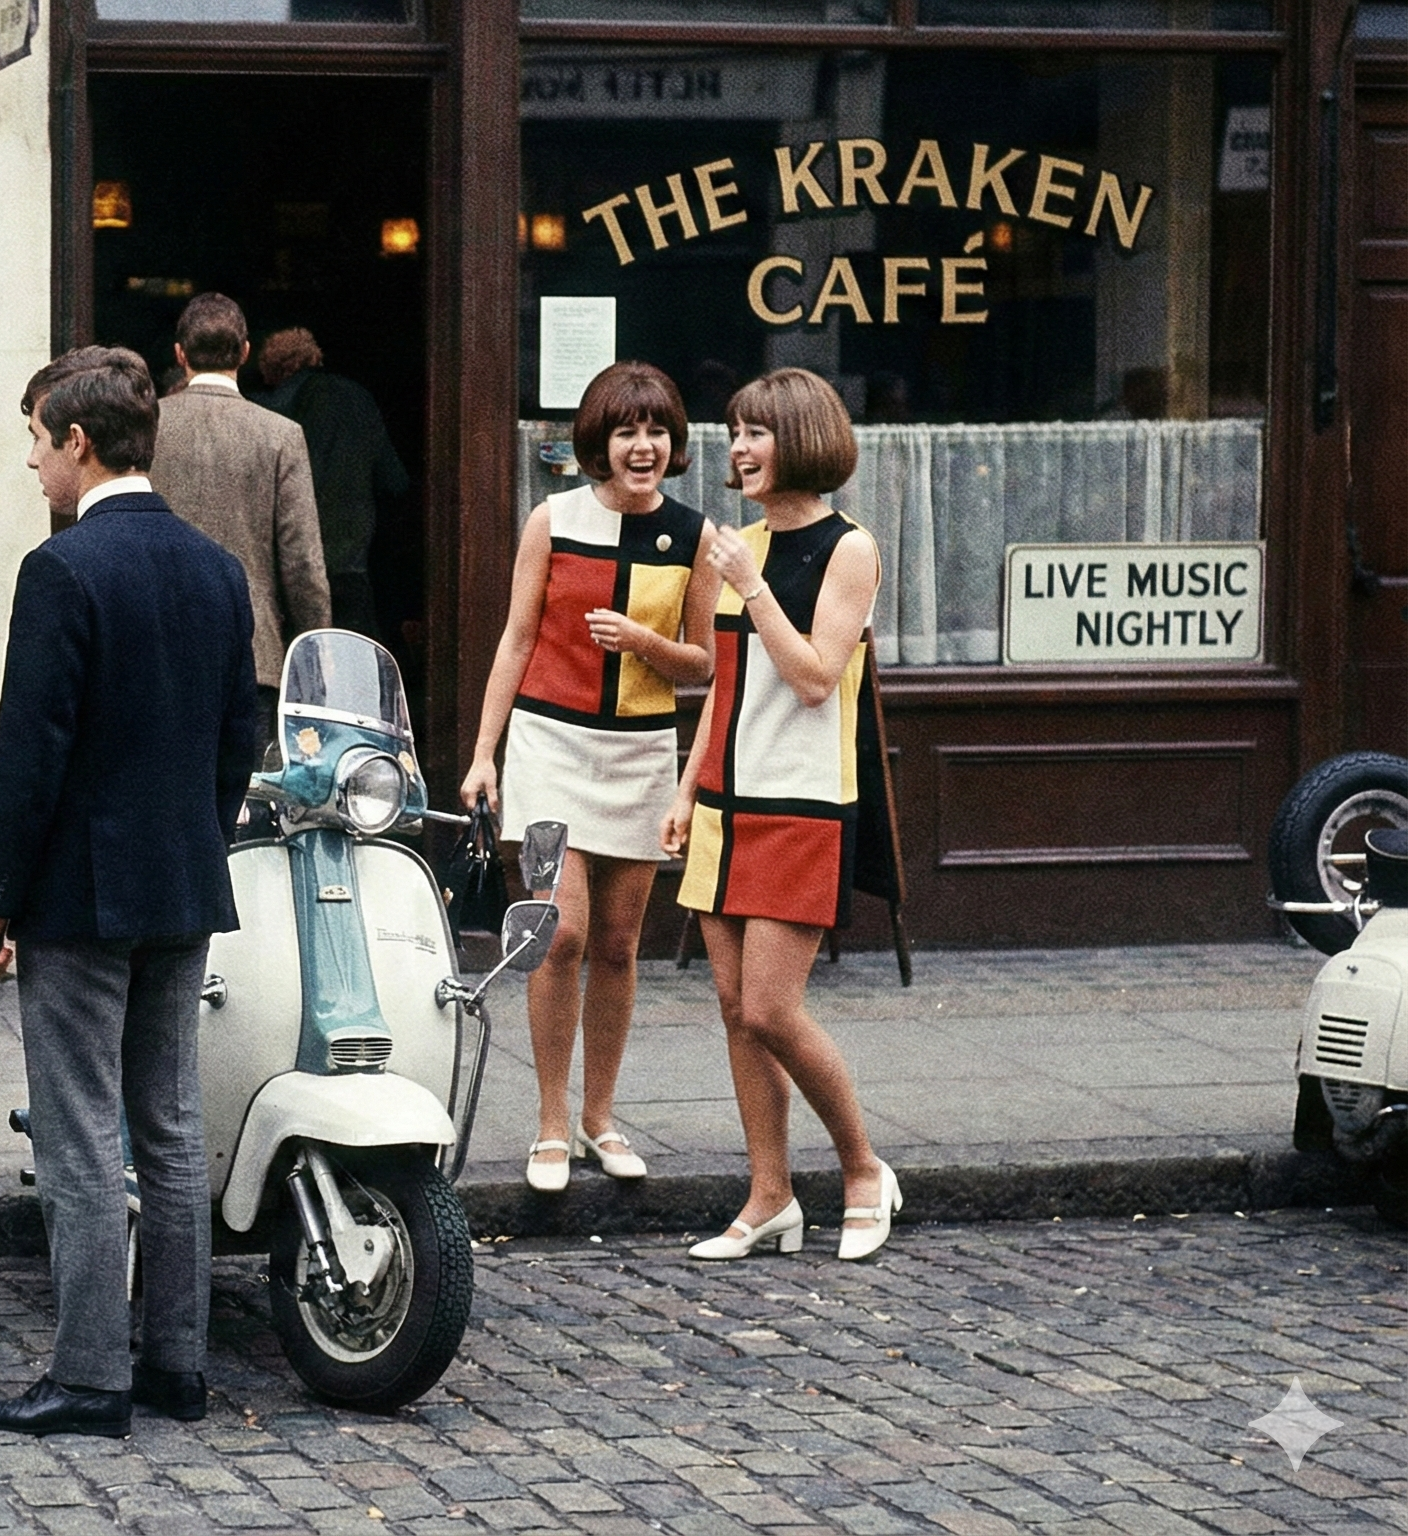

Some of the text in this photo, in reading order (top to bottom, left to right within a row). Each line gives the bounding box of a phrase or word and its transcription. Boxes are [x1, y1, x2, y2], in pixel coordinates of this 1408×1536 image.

[582, 138, 1153, 266] THE KRAKEN
[747, 230, 989, 325] CAFÉ
[1024, 561, 1249, 599] LIVE MUSIC
[1076, 609, 1244, 647] NIGHTLY
